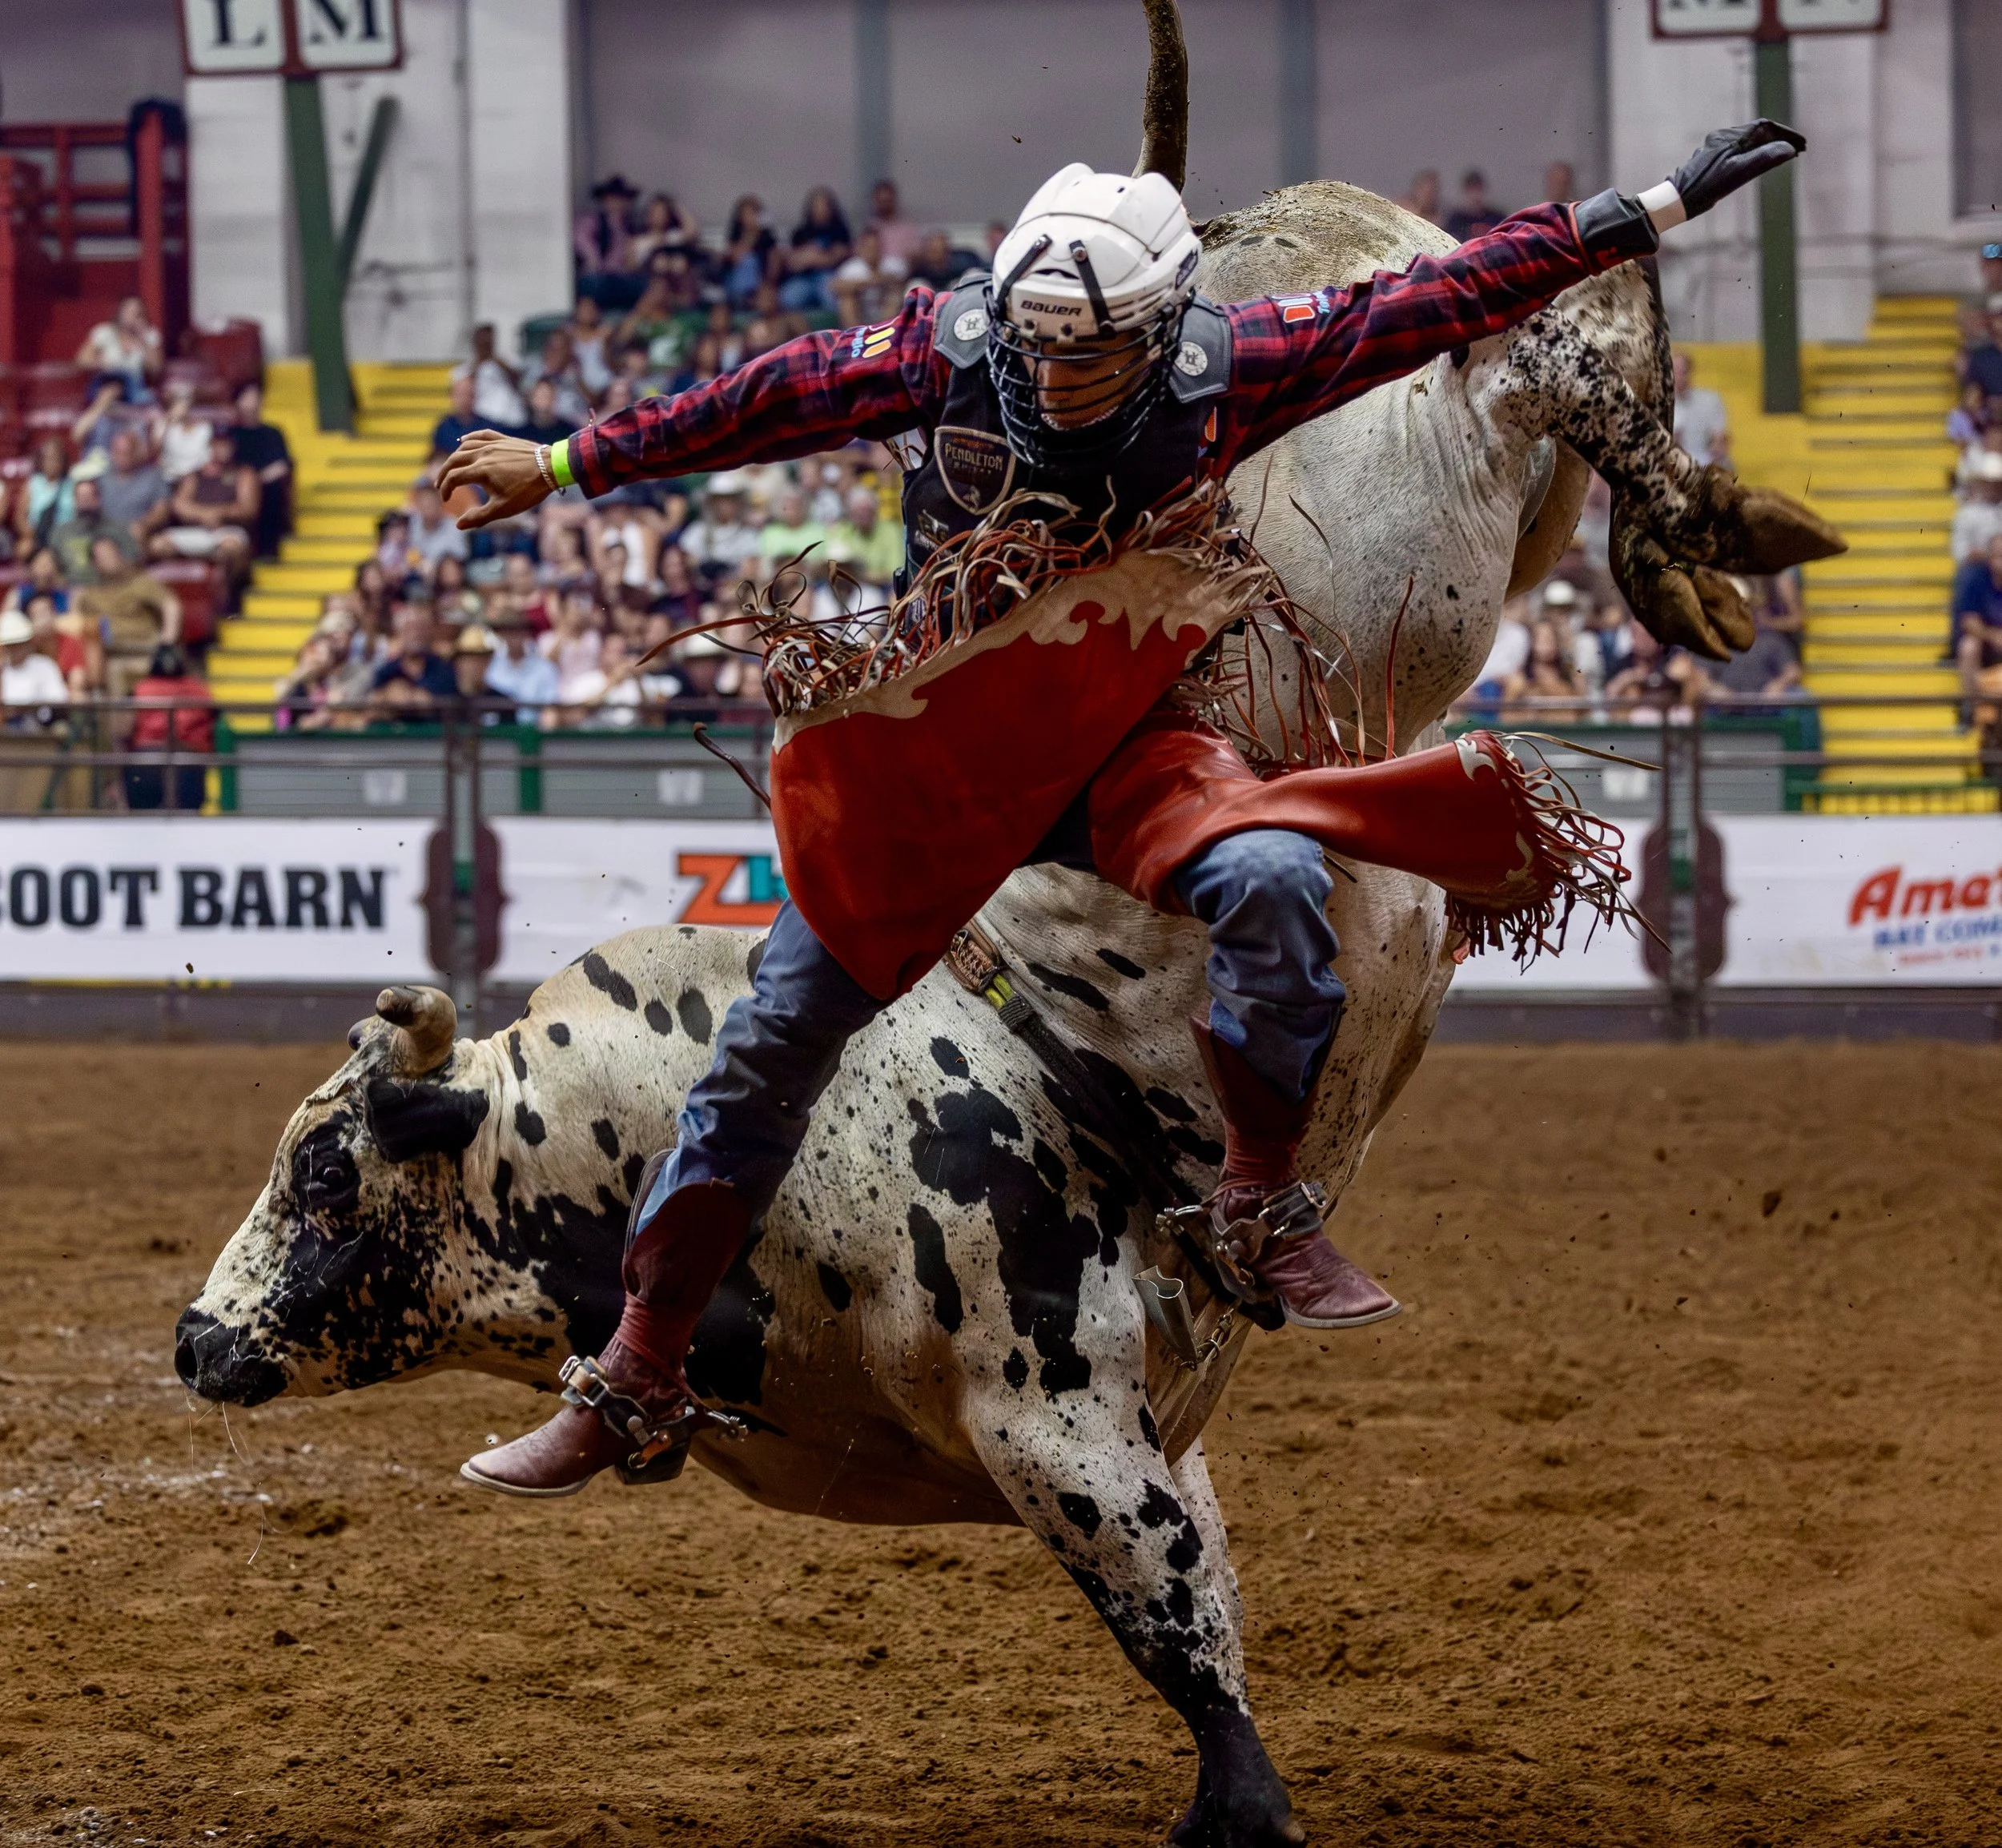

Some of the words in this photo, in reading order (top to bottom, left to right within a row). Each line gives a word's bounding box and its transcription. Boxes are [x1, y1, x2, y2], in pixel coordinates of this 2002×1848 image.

[211, 0, 267, 50] L
[308, 0, 388, 45] M
[1020, 299, 1083, 317] BAUER
[944, 442, 1003, 472] PENDLETON
[0, 865, 160, 930] OOT
[176, 866, 387, 930] BARN
[1847, 865, 2002, 926] Ama
